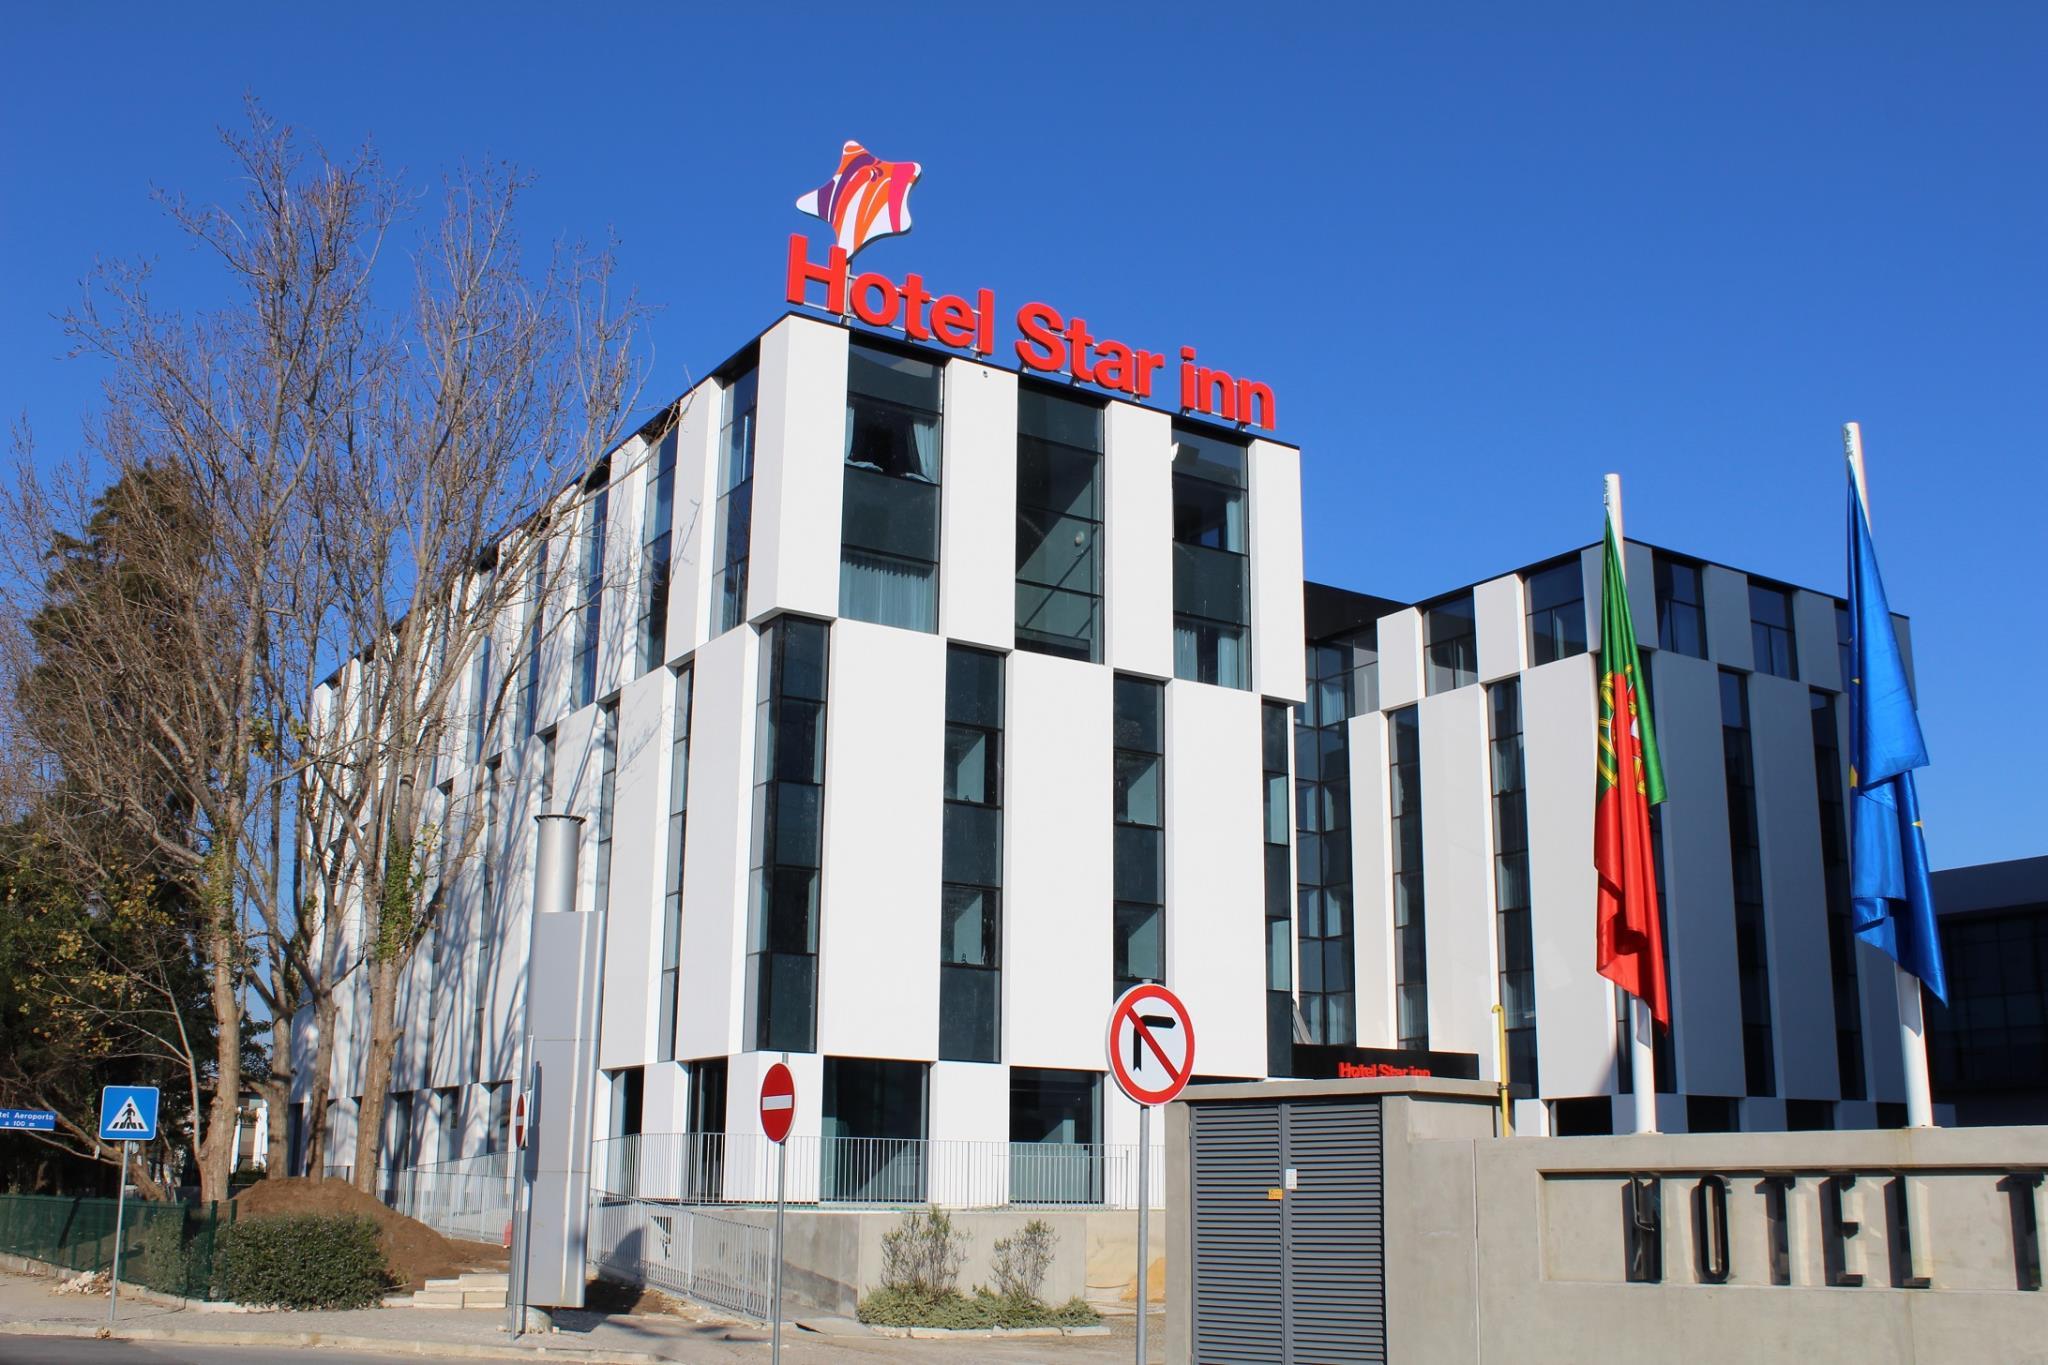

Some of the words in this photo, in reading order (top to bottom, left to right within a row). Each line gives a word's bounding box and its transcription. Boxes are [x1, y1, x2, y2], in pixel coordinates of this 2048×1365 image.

[786, 233, 995, 356] Hotel
[1015, 302, 1165, 398] Star
[1180, 346, 1276, 431] inn
[1339, 1062, 1377, 1078] Hotel
[1378, 1064, 1408, 1077] Star
[1408, 1066, 1431, 1078] inn
[14, 1112, 54, 1120] Aeroporto
[1622, 1173, 1932, 1289] HOTEL
